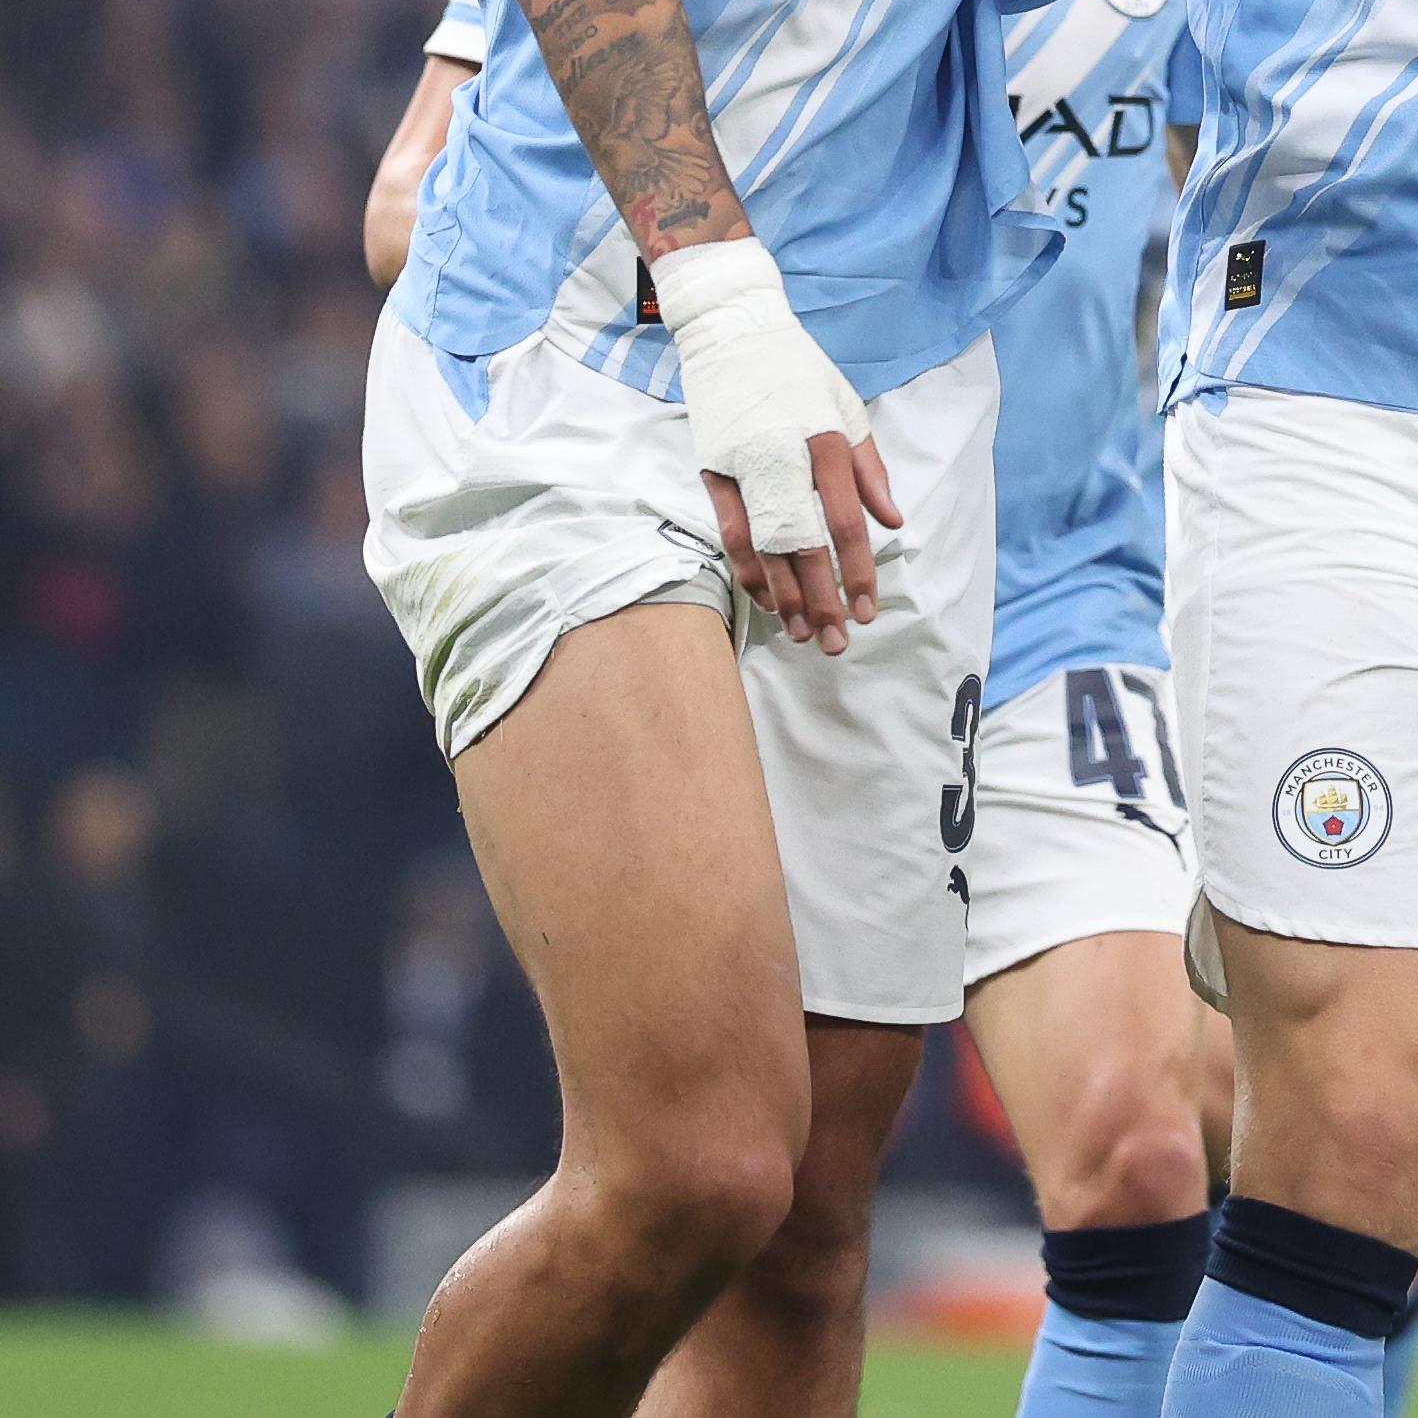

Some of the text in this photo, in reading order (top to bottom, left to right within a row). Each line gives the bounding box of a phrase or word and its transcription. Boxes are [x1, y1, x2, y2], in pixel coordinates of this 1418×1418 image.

[940, 673, 982, 853] 3
[1285, 758, 1378, 796] MANCHESTER
[1318, 848, 1353, 860] CITY
